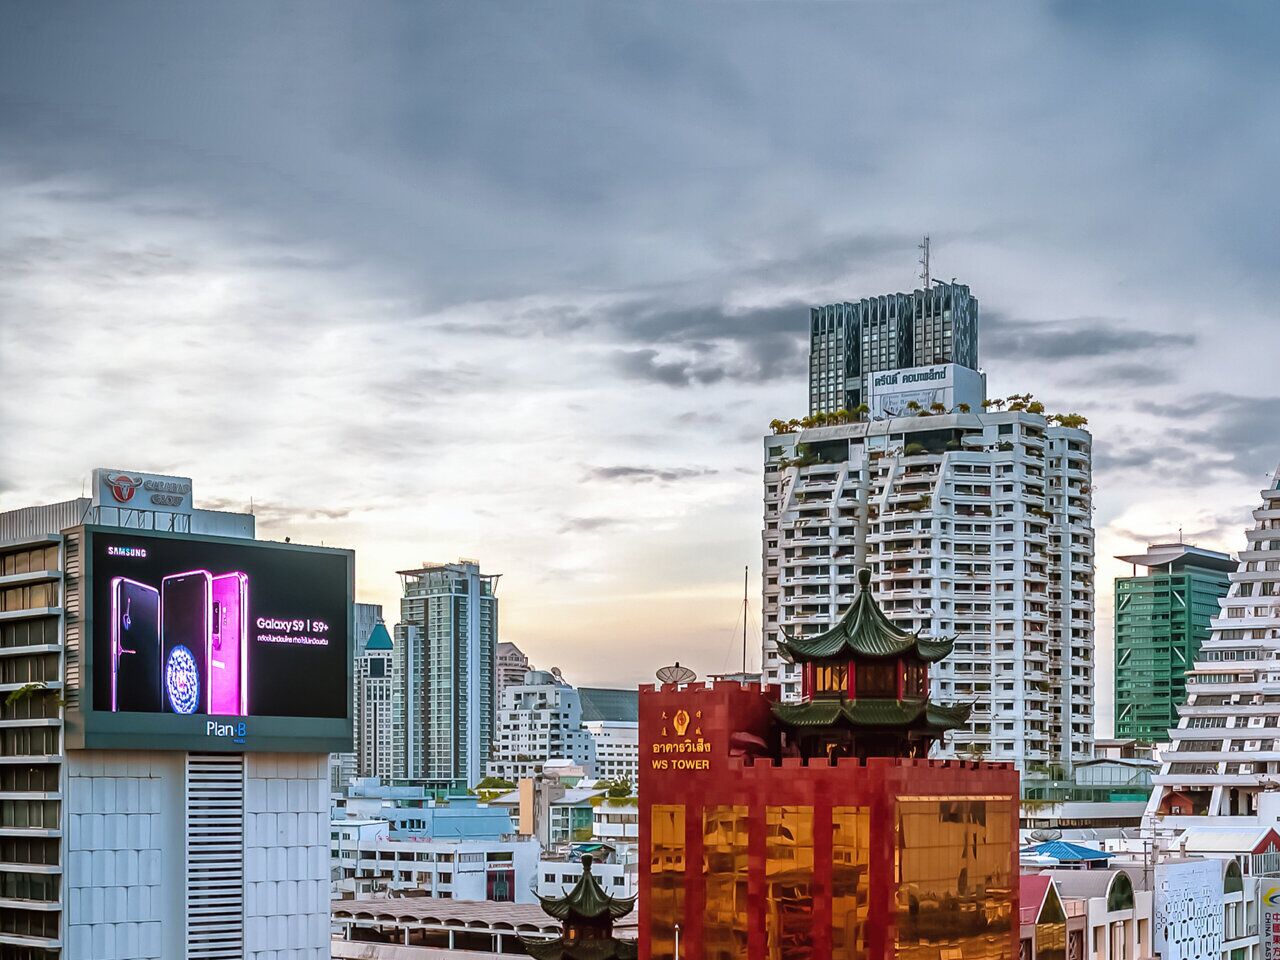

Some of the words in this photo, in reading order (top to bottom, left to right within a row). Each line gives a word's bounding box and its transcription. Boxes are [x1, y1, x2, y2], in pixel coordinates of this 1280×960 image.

[108, 546, 147, 558] SAMSUNG
[256, 618, 292, 633] Galaxy
[293, 620, 304, 632] S9
[313, 621, 329, 632] S9+
[206, 721, 234, 737] Plan
[652, 760, 668, 769] WS
[671, 760, 710, 770] TOWER
